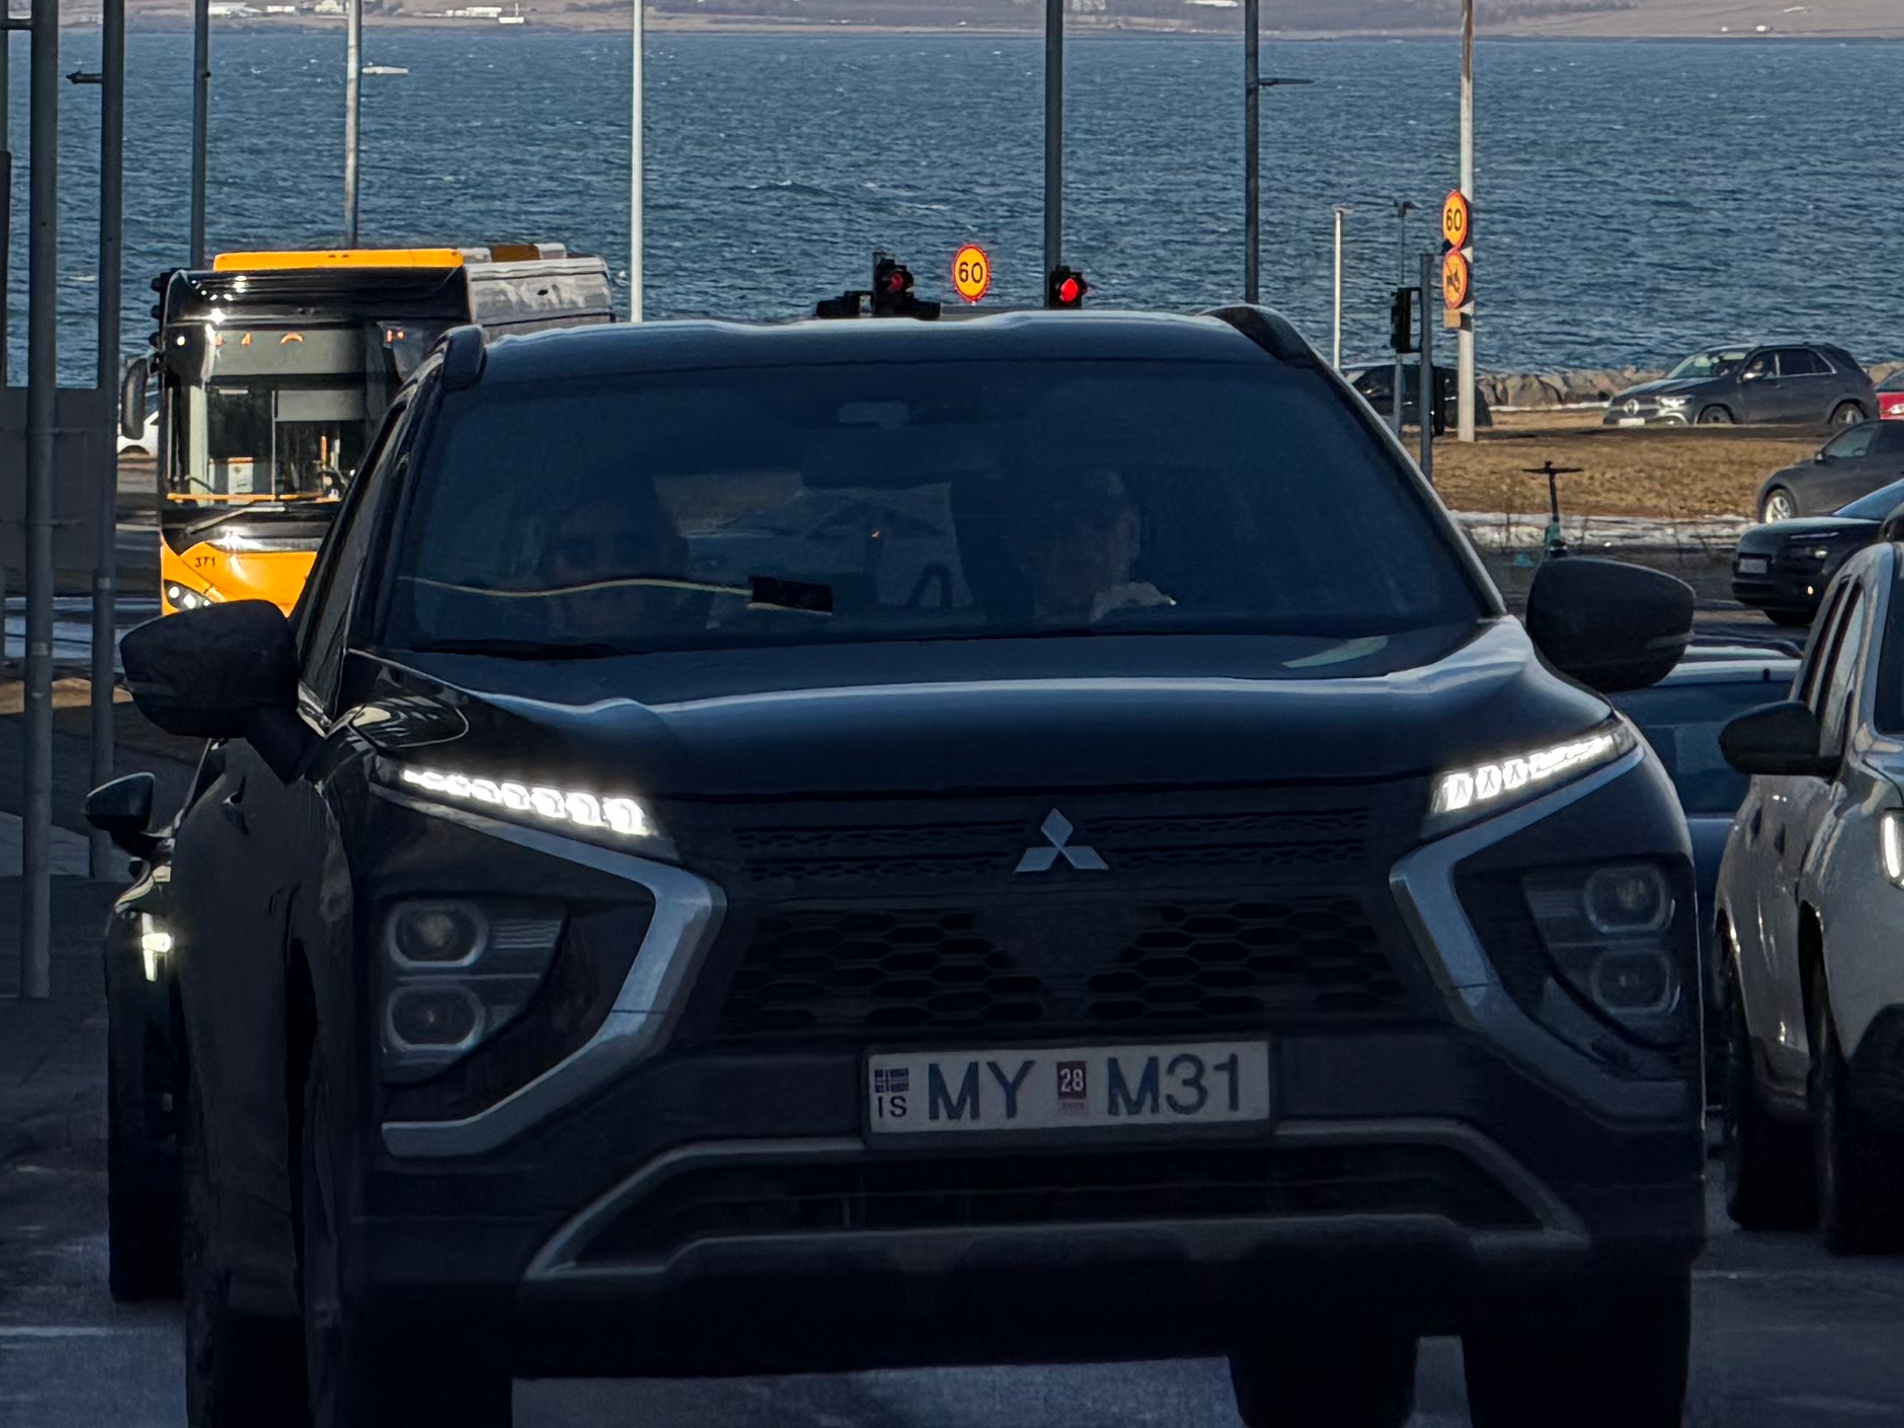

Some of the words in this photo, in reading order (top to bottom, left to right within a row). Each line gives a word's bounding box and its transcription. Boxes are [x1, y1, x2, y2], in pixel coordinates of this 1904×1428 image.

[1446, 208, 1462, 232] 60
[958, 261, 984, 284] 60
[195, 556, 216, 568] 371
[928, 1059, 1036, 1121] MY
[1107, 1052, 1240, 1117] M31
[1060, 1068, 1085, 1093] 28
[877, 1096, 908, 1118] IS
